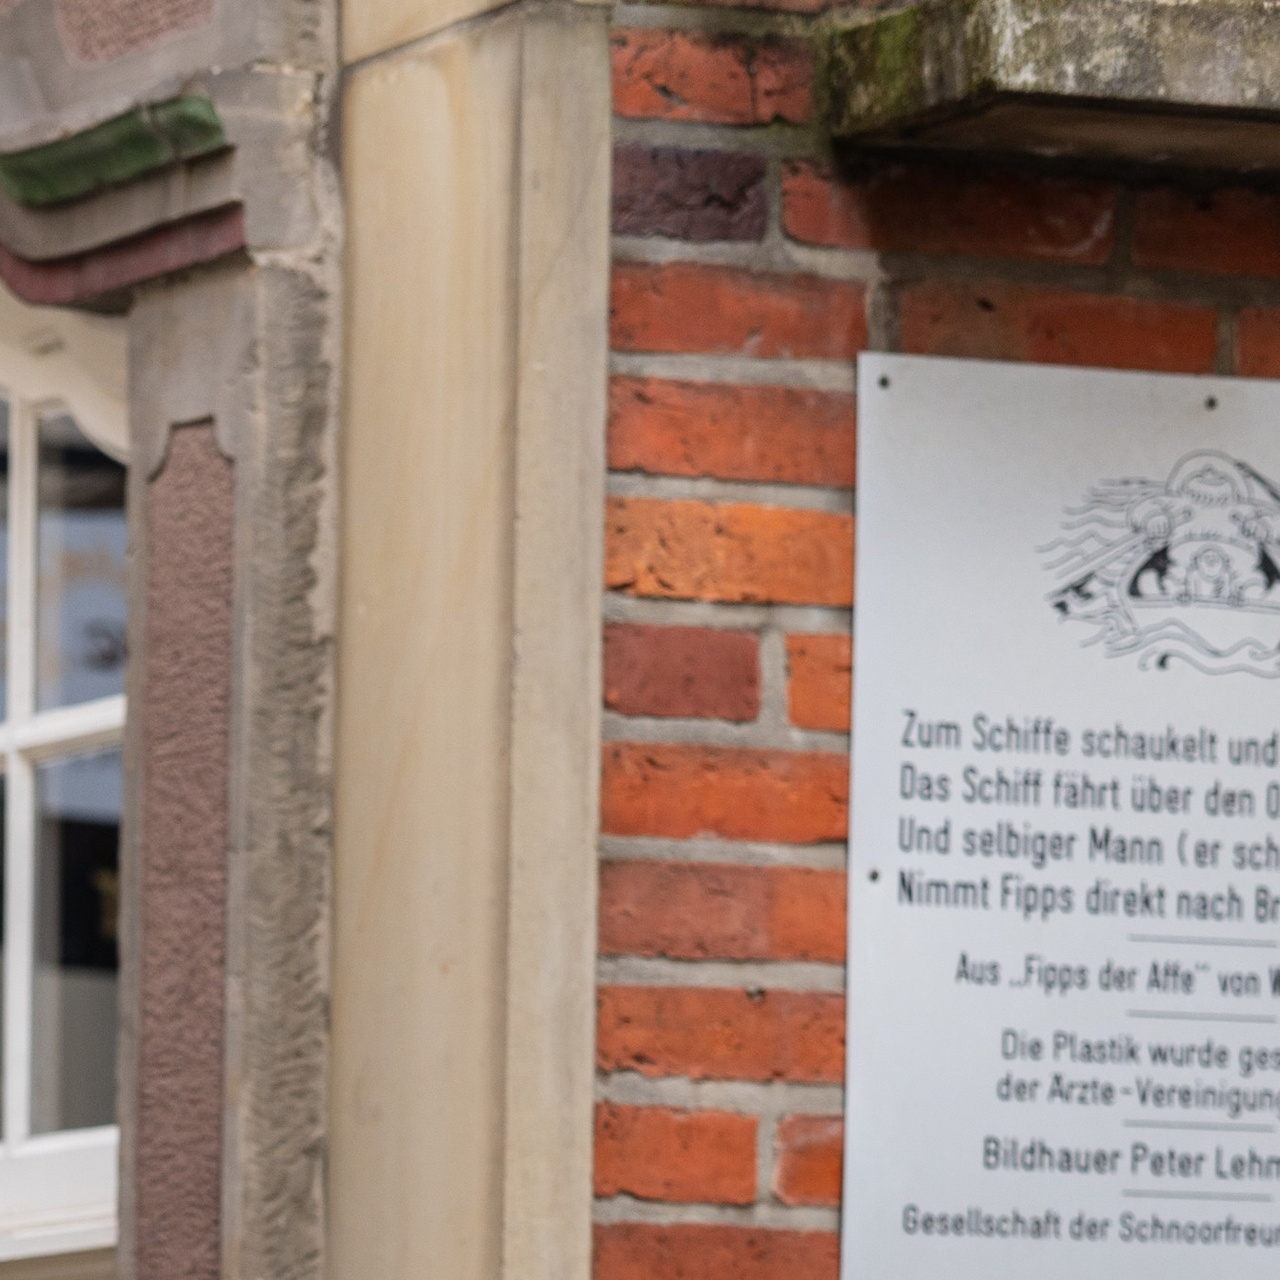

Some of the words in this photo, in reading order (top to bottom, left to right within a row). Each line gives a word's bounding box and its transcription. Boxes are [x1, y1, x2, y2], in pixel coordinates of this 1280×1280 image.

[901, 708, 962, 750] Zum
[971, 712, 1070, 757] Schiffe
[1080, 720, 1219, 764] schaukelt
[1227, 730, 1280, 768] und
[899, 761, 951, 802] Das
[962, 764, 1044, 807] Schiff
[1054, 769, 1121, 811] fährt
[1131, 773, 1194, 815] über
[1204, 780, 1257, 818] den
[899, 815, 951, 855] Und
[962, 820, 1078, 869] selbiger
[1088, 825, 1165, 866] Mann
[898, 868, 991, 909] Nimmt
[1000, 873, 1075, 922] Fipps
[1085, 879, 1168, 918] direkt
[1176, 884, 1244, 923] nach
[955, 950, 1001, 987] Aus
[1098, 957, 1140, 993] der
[1217, 971, 1262, 997] von
[1000, 1027, 1045, 1061] Die
[1052, 1030, 1142, 1066] Plastik
[1148, 1037, 1230, 1070] wurde
[996, 1072, 1040, 1103] der
[981, 1134, 1122, 1174] Bildhauer
[1130, 1141, 1206, 1177] Peter
[902, 1203, 1062, 1240] Gesellschaft
[1070, 1209, 1112, 1242] der
